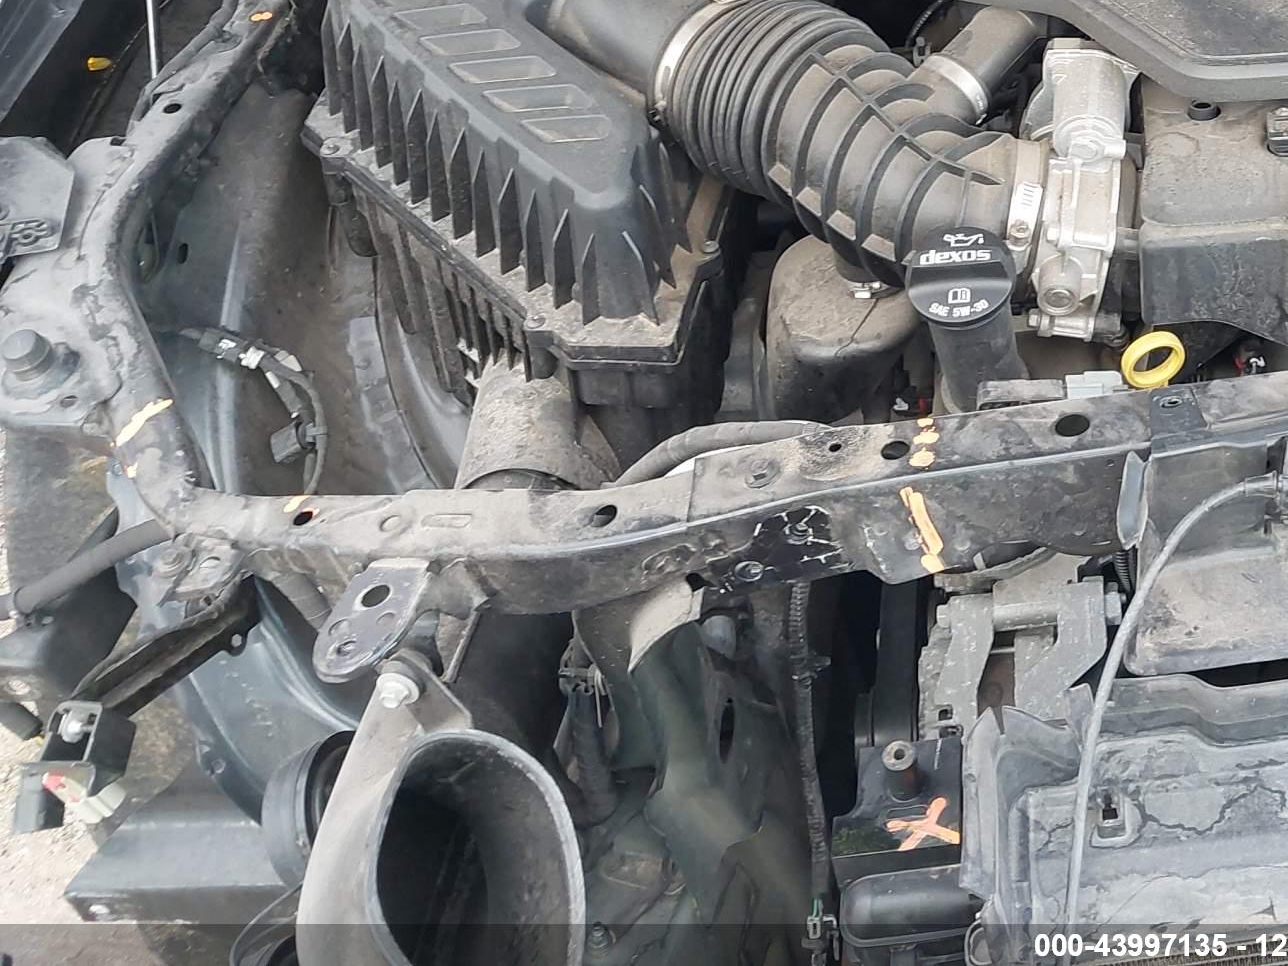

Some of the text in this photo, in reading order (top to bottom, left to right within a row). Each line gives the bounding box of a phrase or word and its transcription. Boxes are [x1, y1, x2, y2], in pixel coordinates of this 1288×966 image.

[919, 249, 992, 265] dexos
[928, 299, 989, 318] SAE 5W-30
